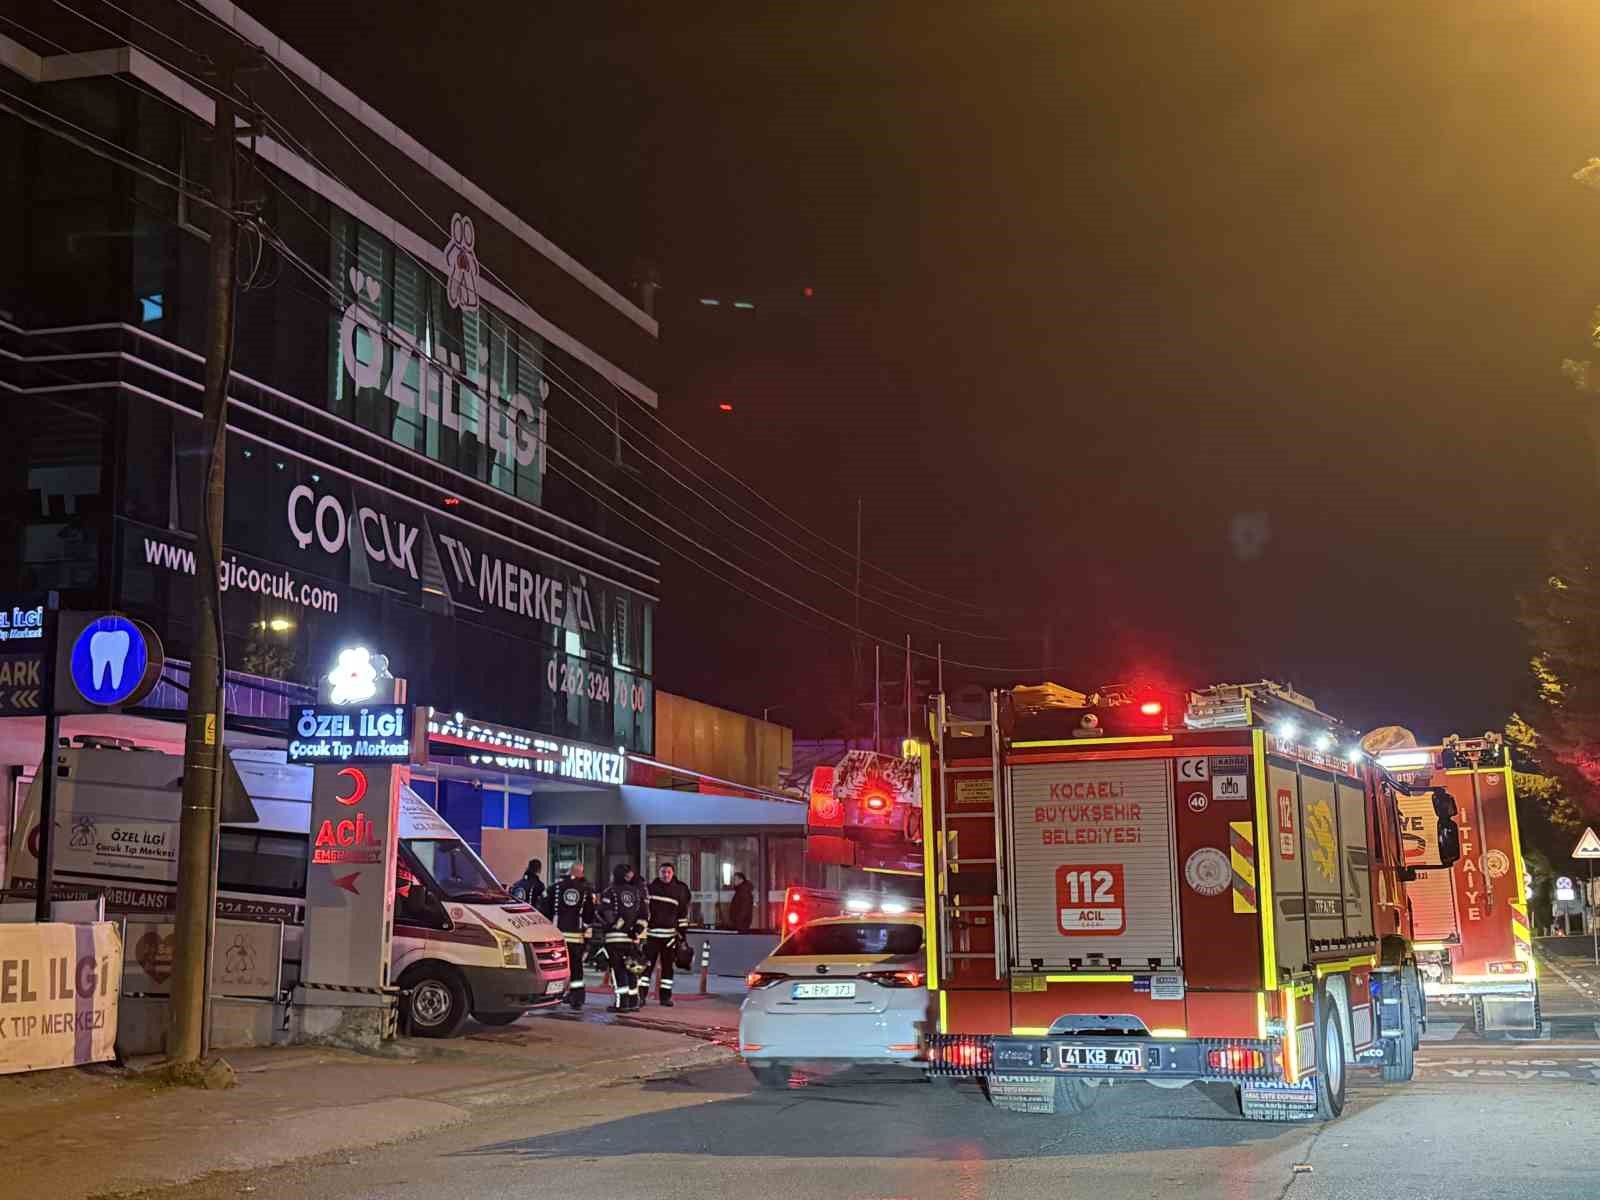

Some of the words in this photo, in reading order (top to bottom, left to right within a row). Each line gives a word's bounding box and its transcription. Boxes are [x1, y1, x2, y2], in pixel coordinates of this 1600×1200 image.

[586, 671, 610, 704] 324
[630, 684, 646, 713] 00
[297, 708, 353, 738] ÖZEL
[358, 707, 403, 737] İLGİ
[289, 739, 331, 760] Çocuk
[331, 740, 353, 760] Tıp
[354, 739, 408, 757] Merkezi
[560, 745, 625, 786] MERKEZİ
[1049, 782, 1125, 801] KOCAELİ
[1190, 795, 1206, 808] 40
[1035, 803, 1142, 824] BÜYÜKŞEHİR
[111, 827, 140, 844] ÖZEL
[314, 813, 381, 848] ACİL
[1041, 827, 1142, 846] BELEDİYESİ
[1066, 870, 1115, 904] 112
[11, 1015, 37, 1038] TIP
[1065, 1049, 1080, 1064] 41
[1085, 1049, 1106, 1064] KB
[1113, 1050, 1136, 1065] 401
